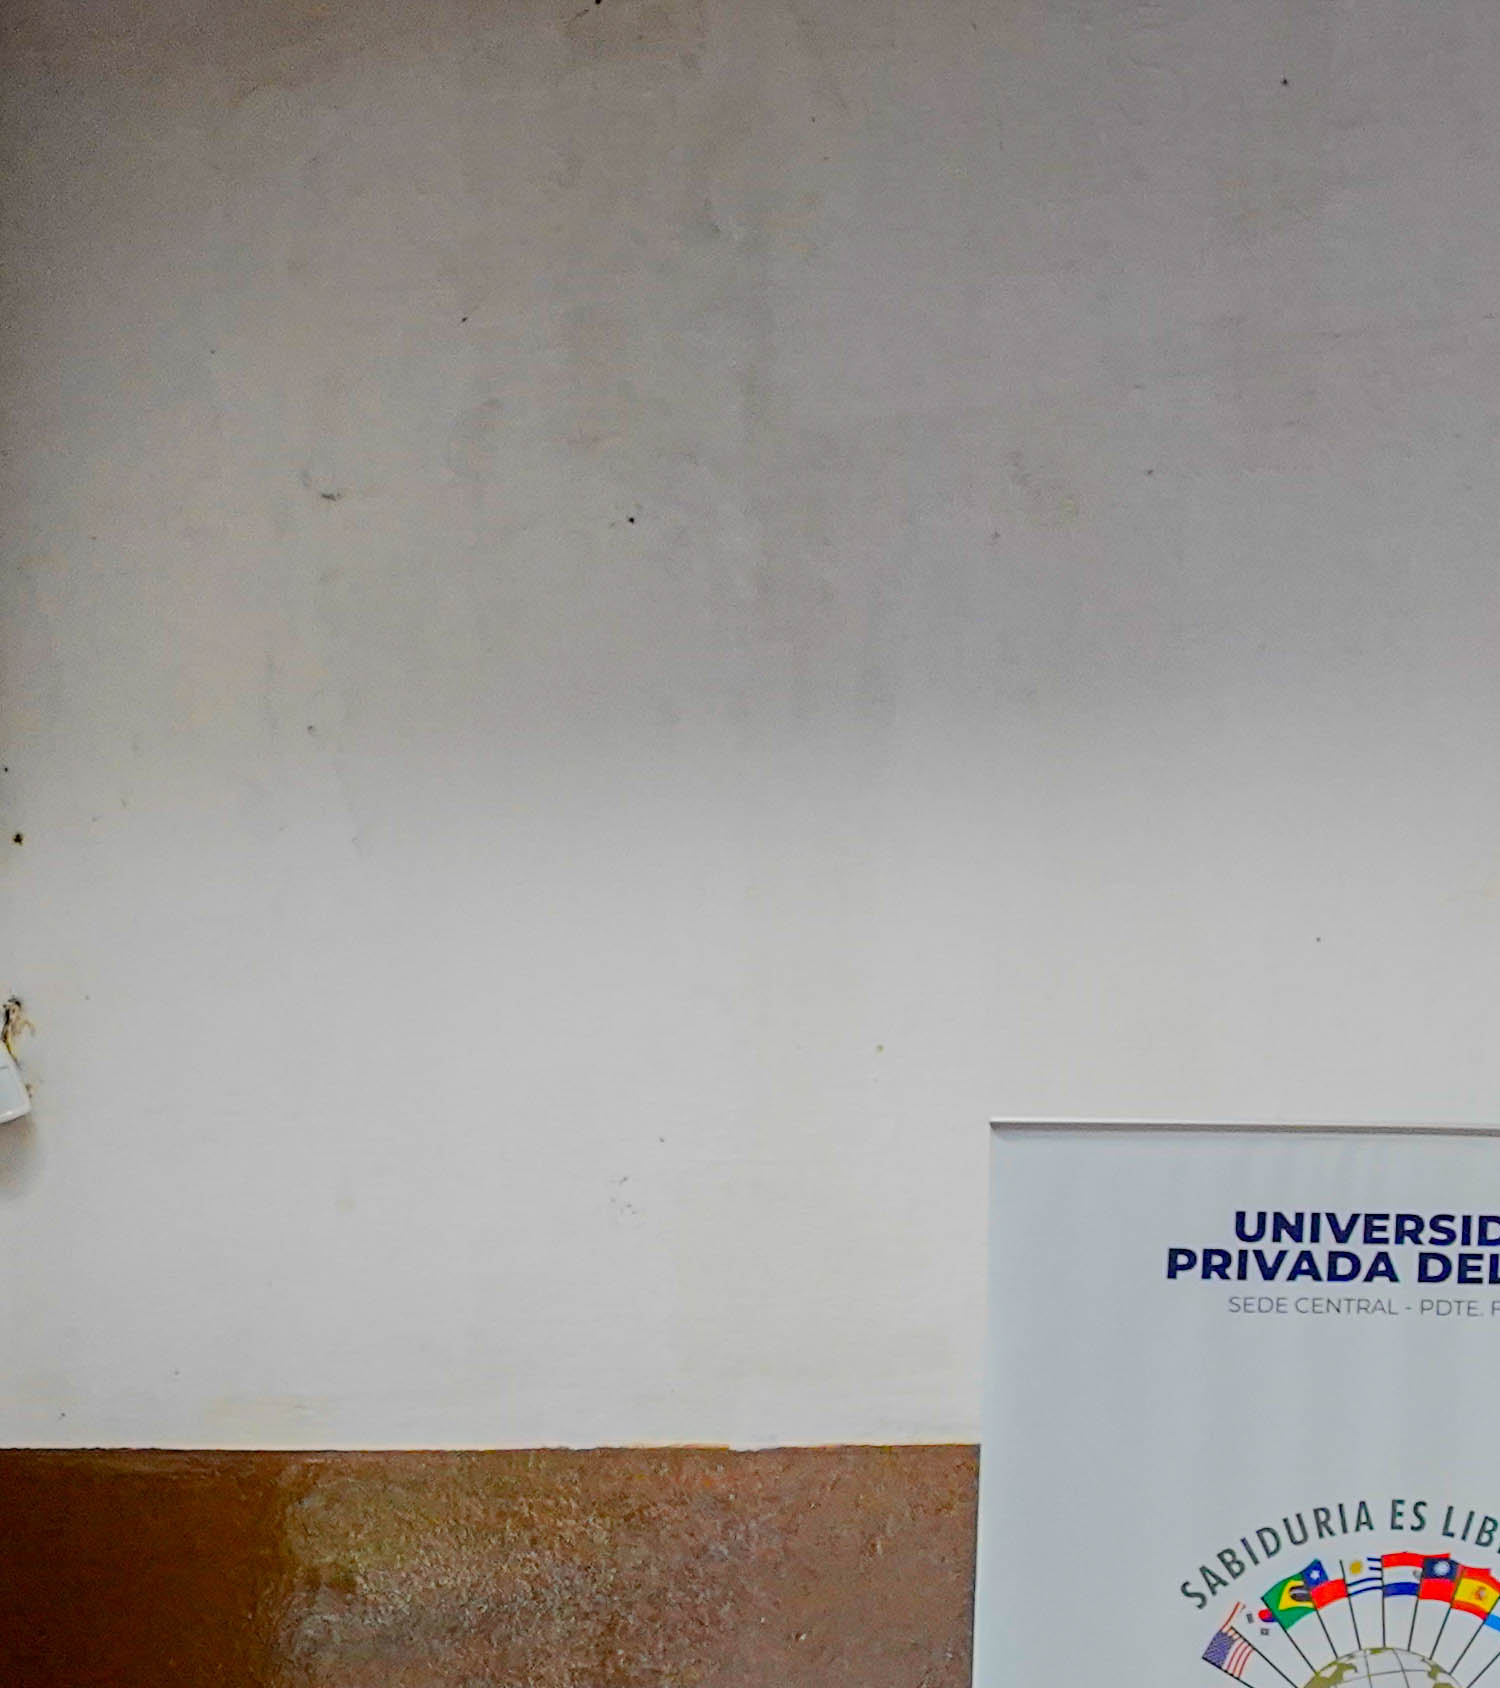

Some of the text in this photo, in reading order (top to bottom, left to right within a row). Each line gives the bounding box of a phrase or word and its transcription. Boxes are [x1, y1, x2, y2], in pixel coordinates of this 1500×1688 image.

[1166, 1247, 1399, 1284] PRIVADA
[1228, 1296, 1288, 1314] SEDE
[1295, 1297, 1398, 1316] CENTRAL
[1420, 1299, 1483, 1317] PDTE.
[1181, 1500, 1374, 1609] SABIDURIA
[1390, 1499, 1428, 1532] ES
